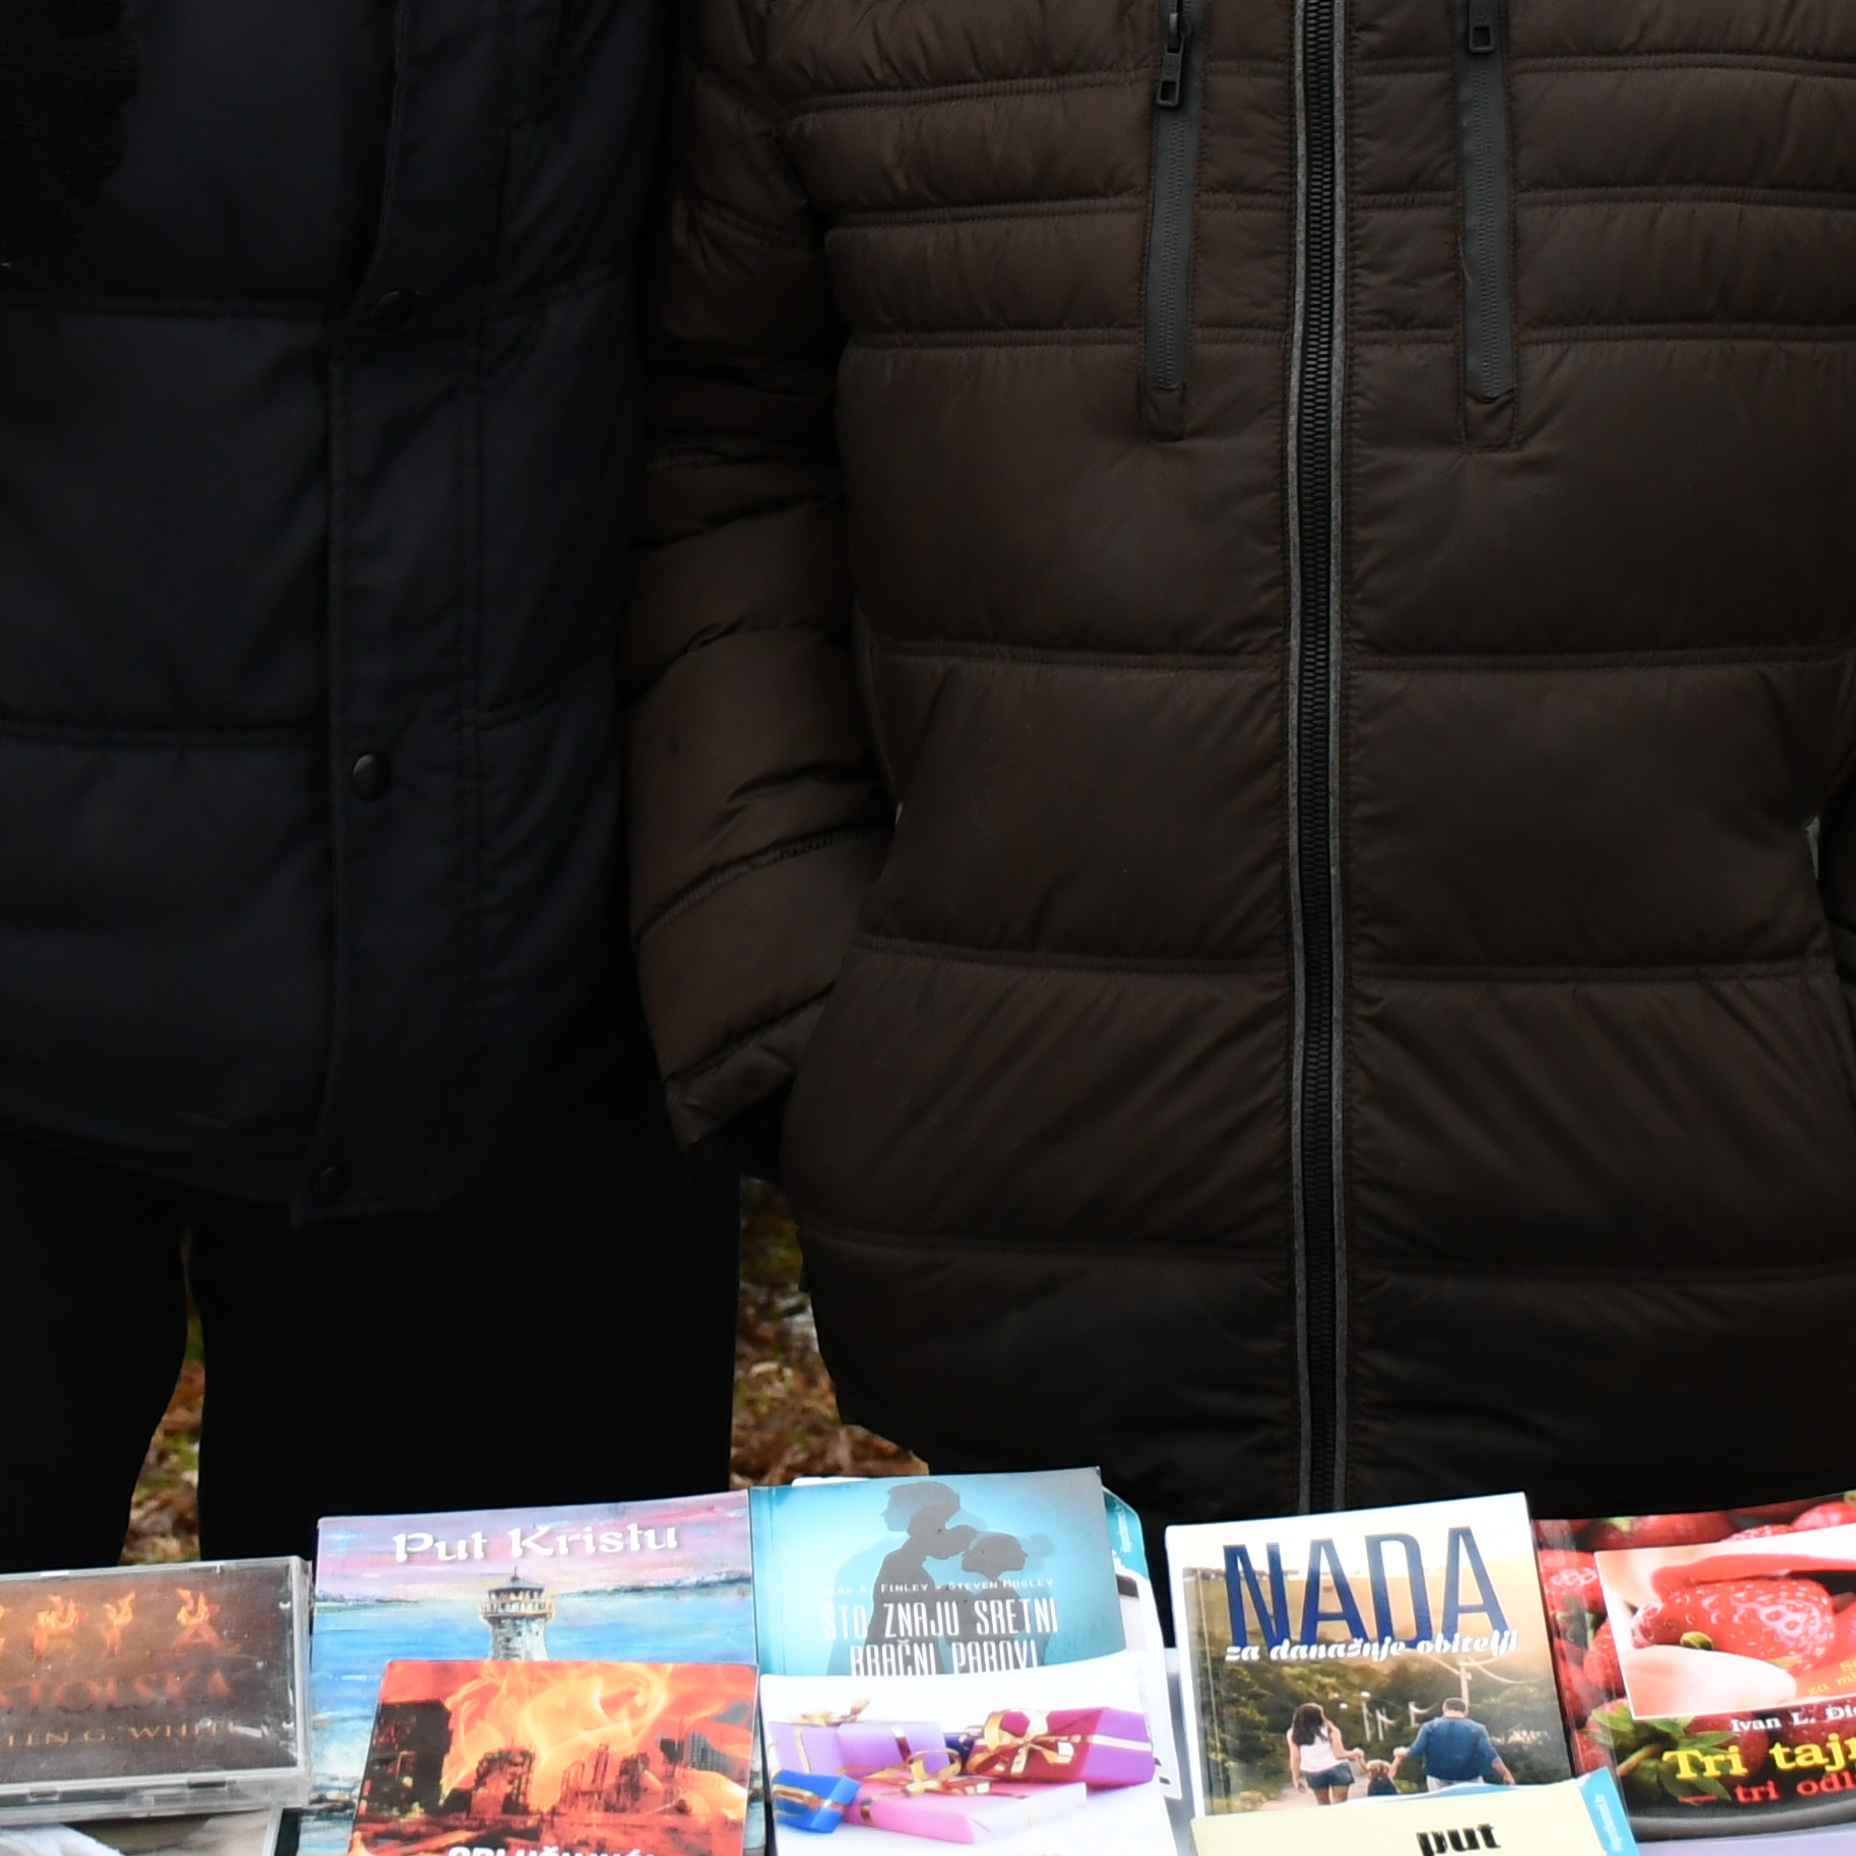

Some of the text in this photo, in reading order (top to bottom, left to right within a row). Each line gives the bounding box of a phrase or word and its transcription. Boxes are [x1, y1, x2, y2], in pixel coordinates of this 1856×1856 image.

[392, 1521, 679, 1564] Put Kristu
[1221, 1525, 1511, 1651] NADA
[883, 1600, 960, 1638] ZNAJU
[973, 1597, 1059, 1636] SRETNI
[850, 1638, 1039, 1677] BRAČNI PAROVI
[1225, 1629, 1520, 1662] za današnje obitelji
[1730, 1716, 1782, 1733] Ivan
[1792, 1710, 1817, 1726] L.
[1662, 1744, 1748, 1782] Tri
[1734, 1778, 1780, 1805] tri
[1416, 1822, 1502, 1856] put
